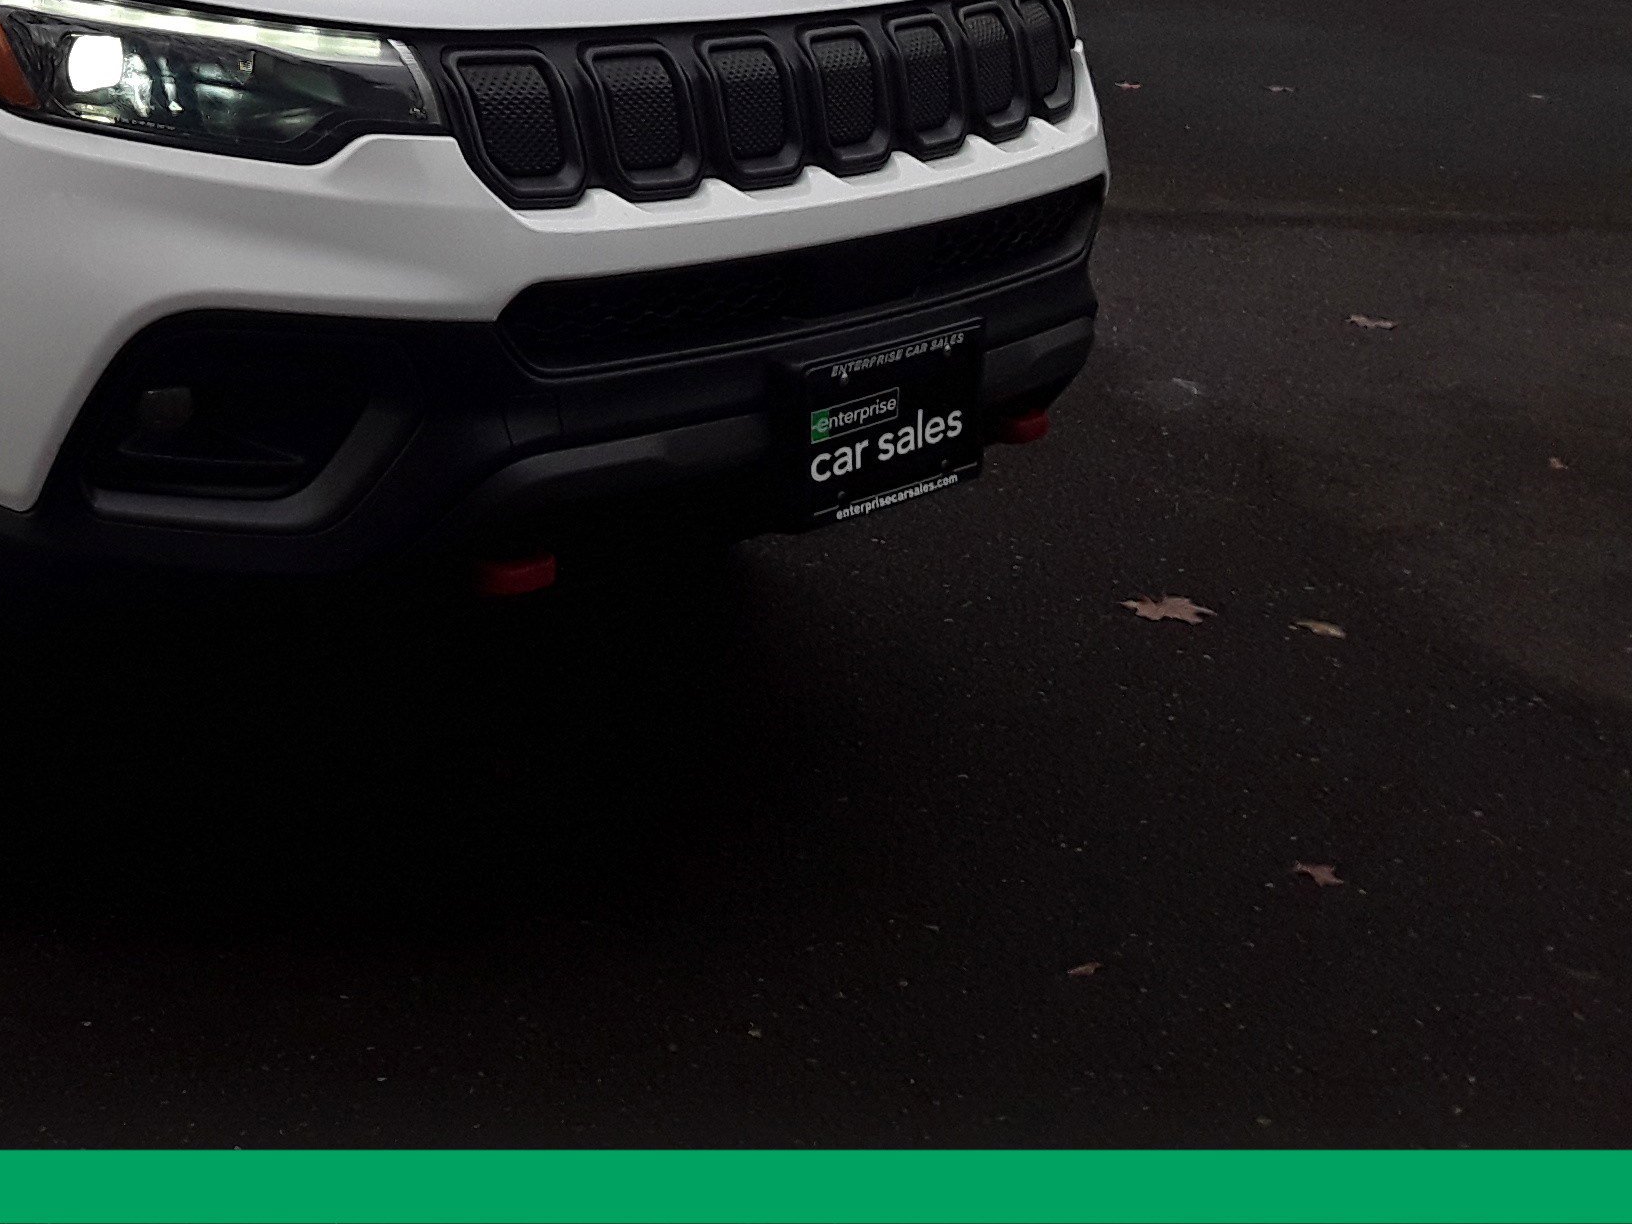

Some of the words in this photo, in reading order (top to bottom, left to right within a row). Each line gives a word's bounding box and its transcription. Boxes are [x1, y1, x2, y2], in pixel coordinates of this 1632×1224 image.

[831, 349, 904, 378] ENTERPRISE
[905, 342, 928, 358] CAR
[817, 398, 897, 433] enterprise
[810, 439, 869, 482] car
[877, 408, 963, 461] sales
[836, 474, 958, 520] enterprisecarsales.com
